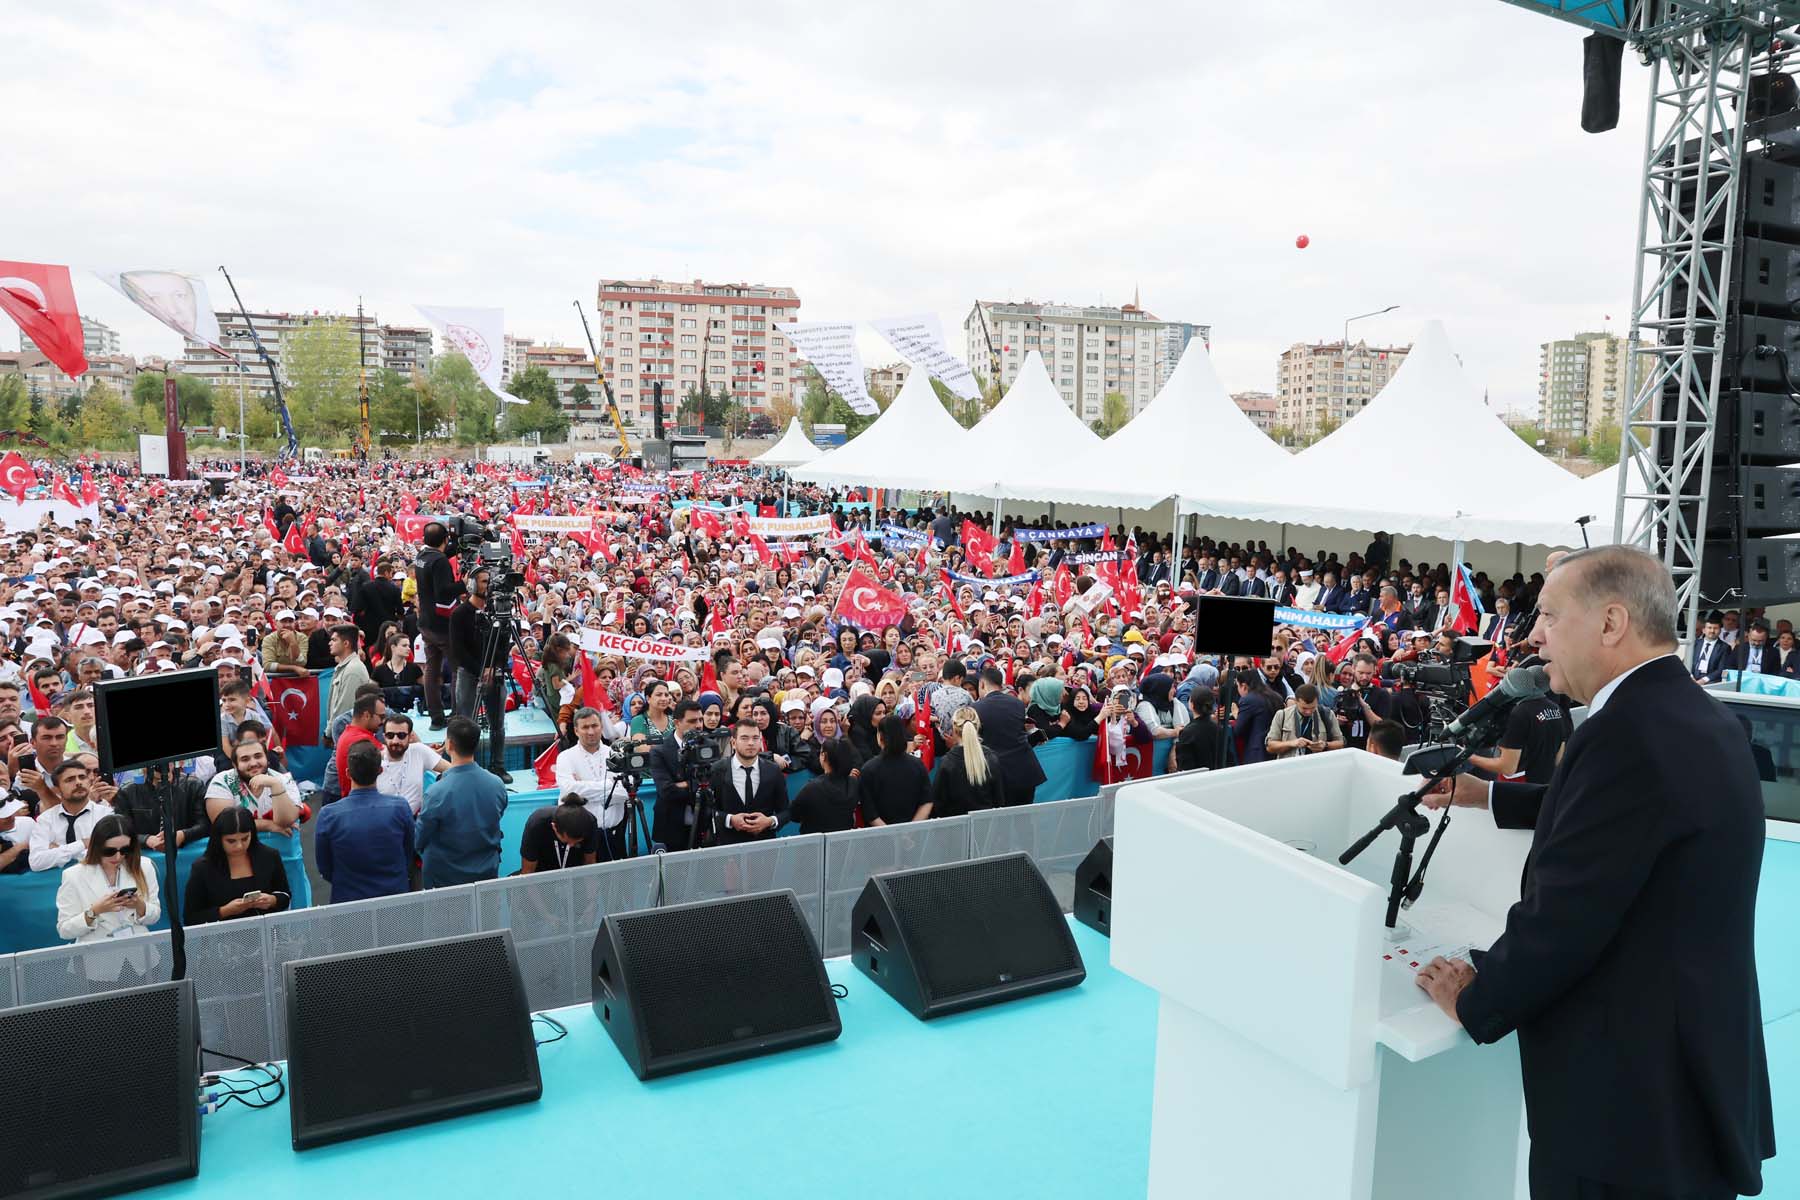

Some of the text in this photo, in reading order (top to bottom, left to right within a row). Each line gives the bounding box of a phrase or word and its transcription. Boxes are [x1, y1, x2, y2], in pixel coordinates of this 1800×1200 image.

[767, 517, 831, 531] PURSAKLAR
[1029, 527, 1093, 540] ÇANKAYA
[1075, 550, 1118, 564] SİNCAN
